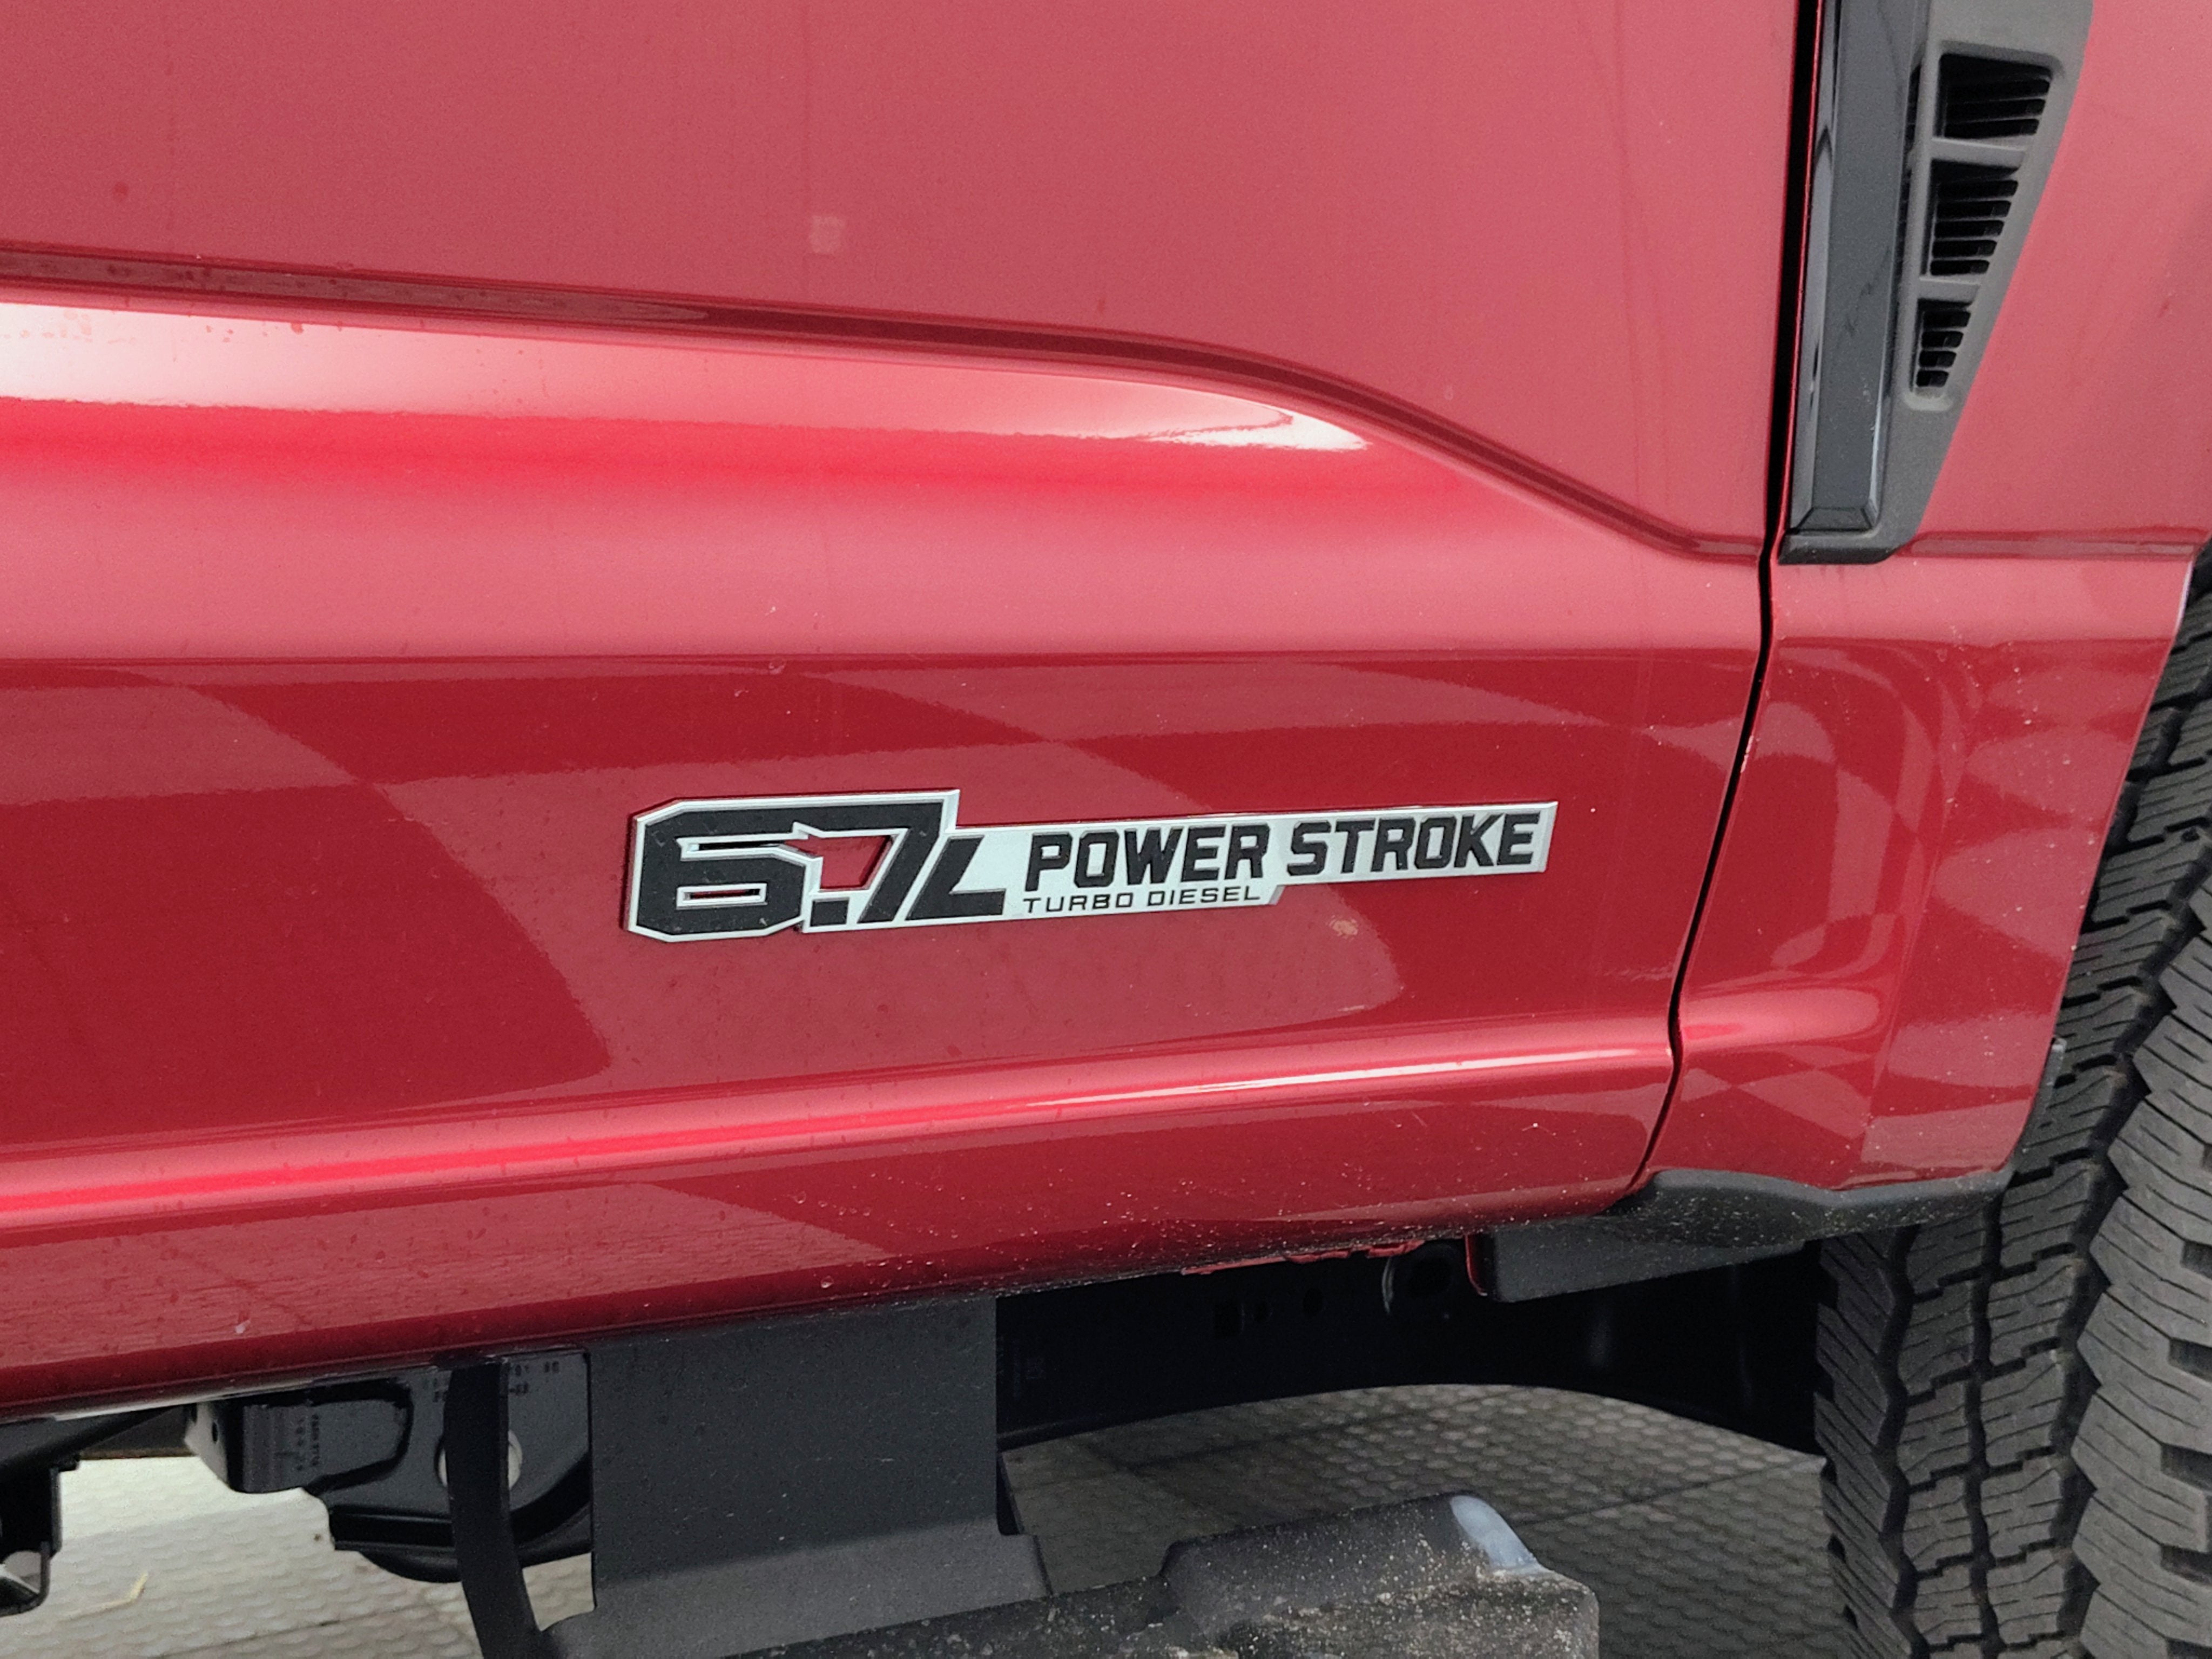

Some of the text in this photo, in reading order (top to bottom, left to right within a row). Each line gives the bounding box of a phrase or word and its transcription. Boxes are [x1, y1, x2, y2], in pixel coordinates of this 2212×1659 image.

[635, 801, 1006, 935] 6.7L
[1024, 810, 1541, 892] POWER STROKE
[1023, 885, 1261, 913] TURBO DIESEL
